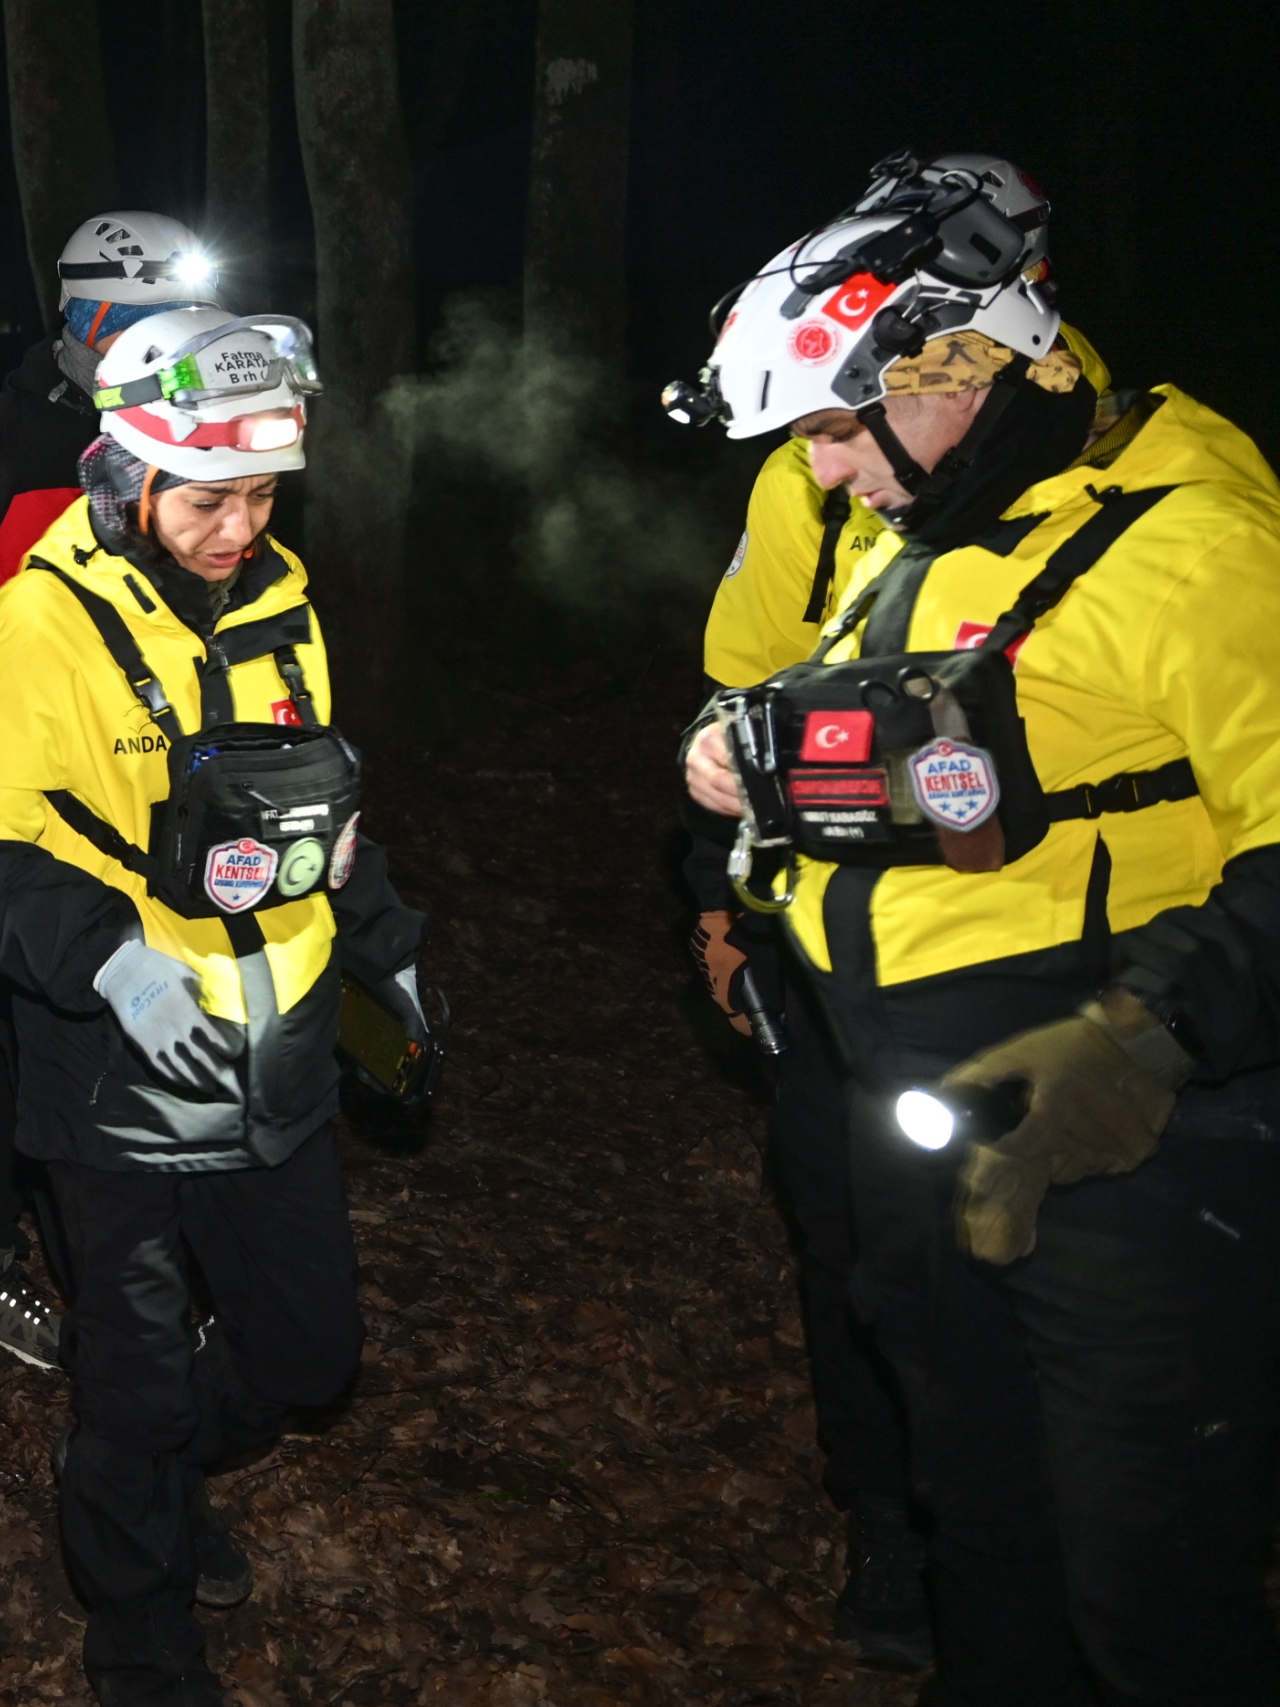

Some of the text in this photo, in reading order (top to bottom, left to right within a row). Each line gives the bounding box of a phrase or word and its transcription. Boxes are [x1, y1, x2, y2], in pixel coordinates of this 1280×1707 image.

[221, 351, 263, 362] Fatma
[114, 735, 167, 754] ANDA
[928, 760, 971, 774] AFAD
[925, 772, 984, 792] KENTSEL
[226, 855, 261, 866] AFAD
[216, 865, 265, 880] KENTSEL
